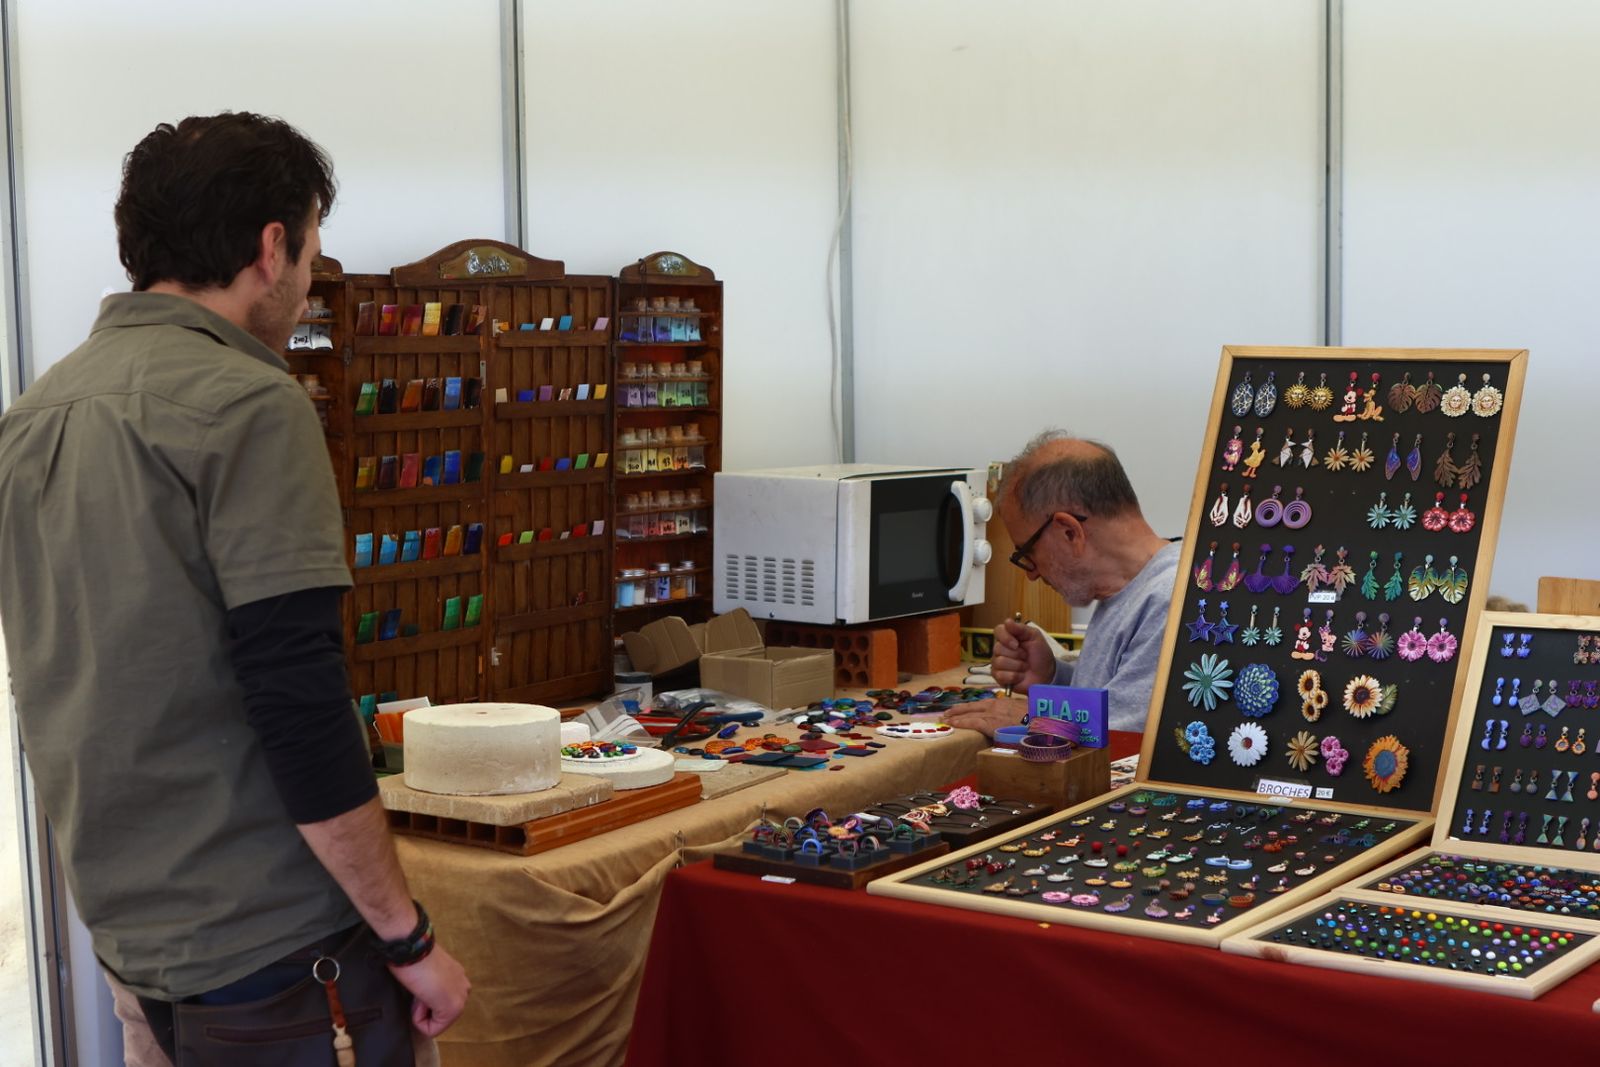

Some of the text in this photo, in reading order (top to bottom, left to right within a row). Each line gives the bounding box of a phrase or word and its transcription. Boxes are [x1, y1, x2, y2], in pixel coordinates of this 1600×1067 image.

[1036, 698, 1089, 723] PLA 3D
[1259, 782, 1310, 797] BROCHES
